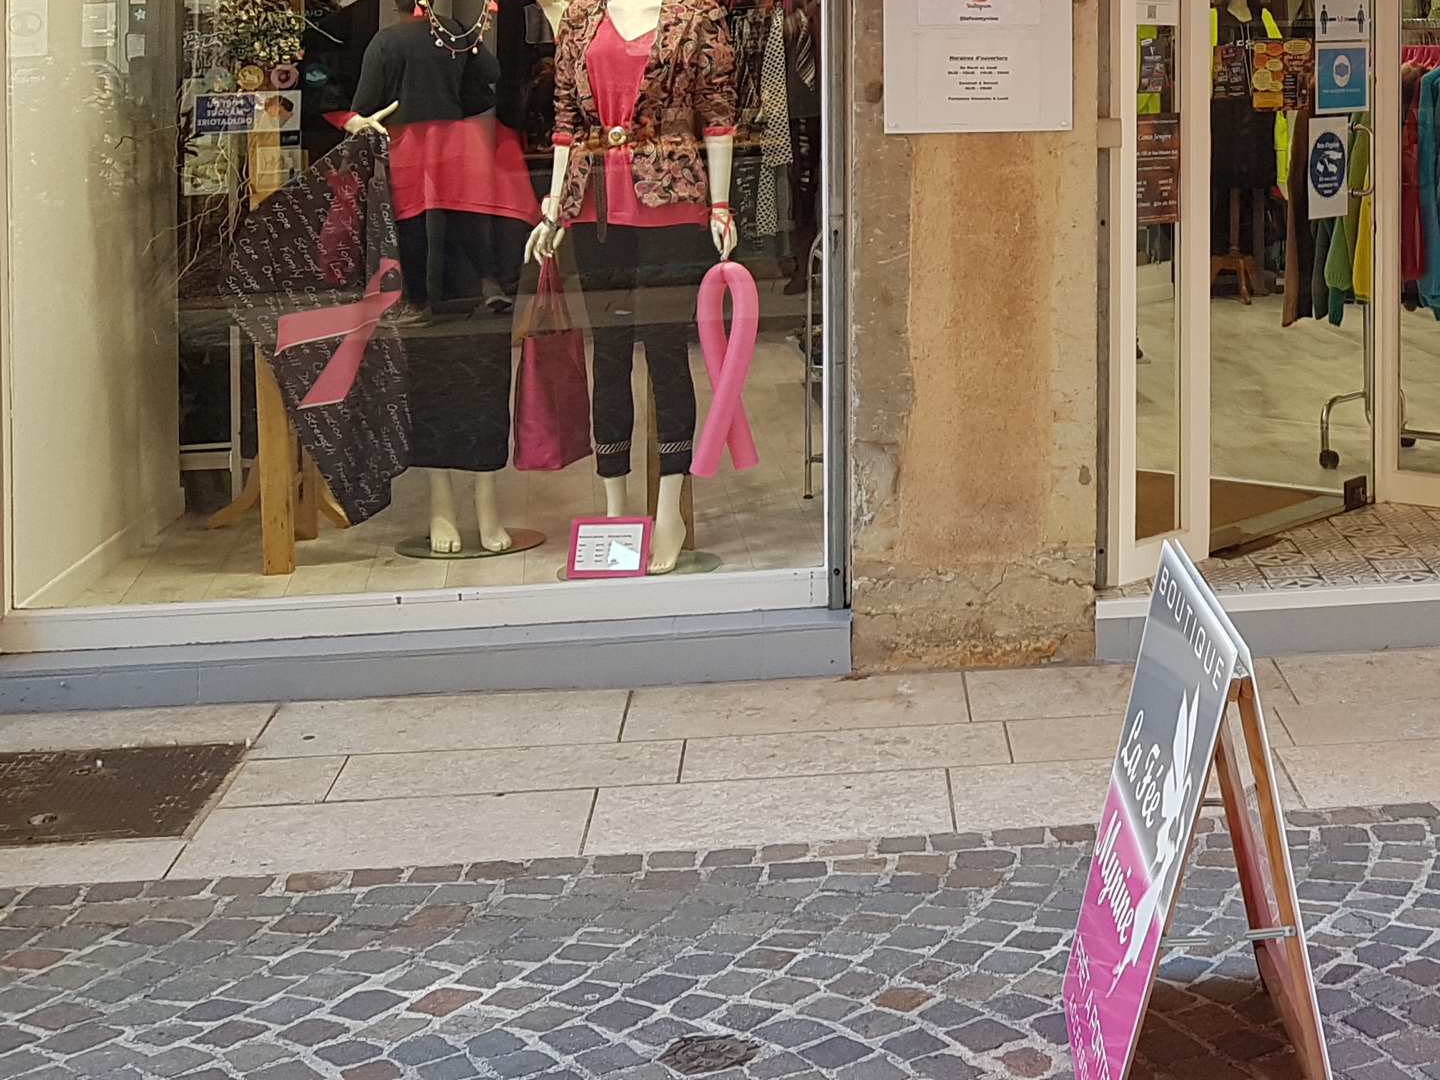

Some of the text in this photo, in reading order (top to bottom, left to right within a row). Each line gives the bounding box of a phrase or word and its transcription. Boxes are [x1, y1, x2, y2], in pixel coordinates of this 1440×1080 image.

[1159, 566, 1225, 691] BOUTIQUE
[1121, 710, 1164, 828] La Fée
[1095, 809, 1134, 944] Mynine
[1069, 992, 1090, 1080] ACCESSO
[1089, 1004, 1111, 1080] PORTE
